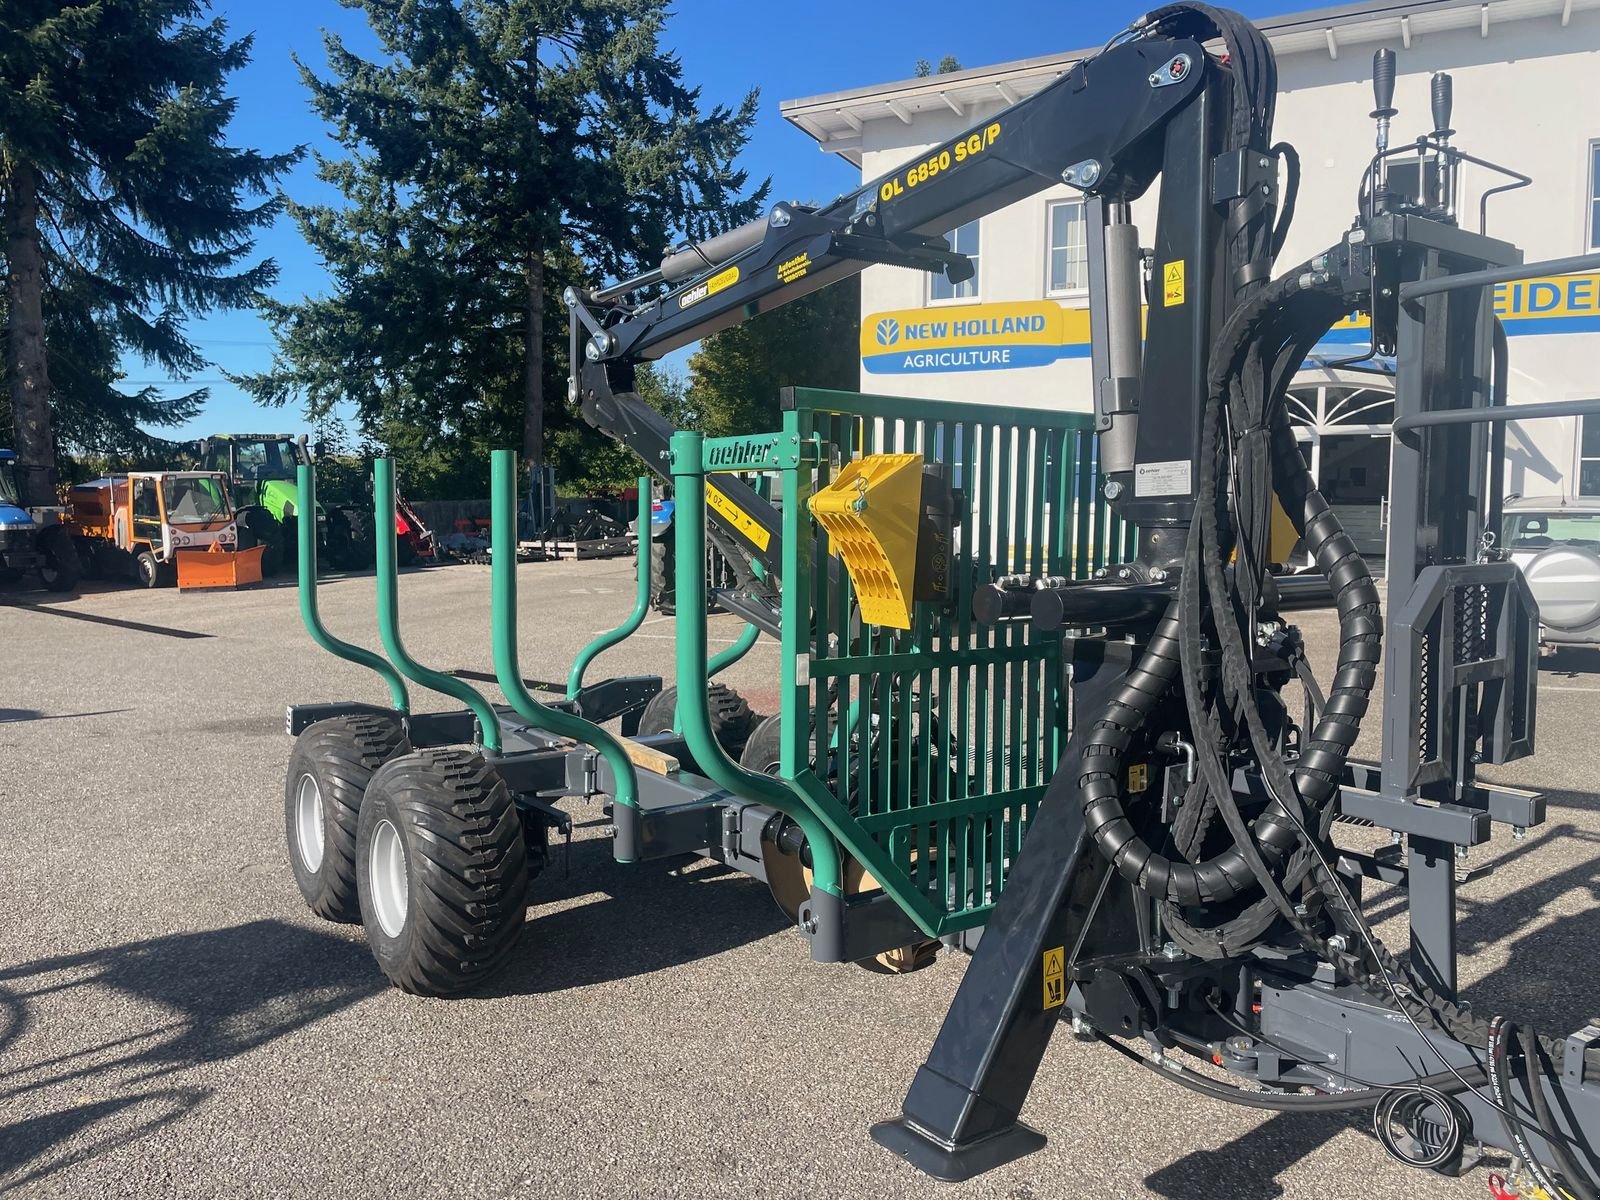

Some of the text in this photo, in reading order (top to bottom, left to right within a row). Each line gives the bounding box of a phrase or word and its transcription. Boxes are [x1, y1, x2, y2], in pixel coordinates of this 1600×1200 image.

[881, 123, 1001, 201] OL 6850 SG/P
[681, 284, 708, 307] oehler
[905, 315, 1046, 340] NEW HOLLAND
[903, 349, 1011, 368] AGRICULTURE
[709, 440, 772, 465] oehler
